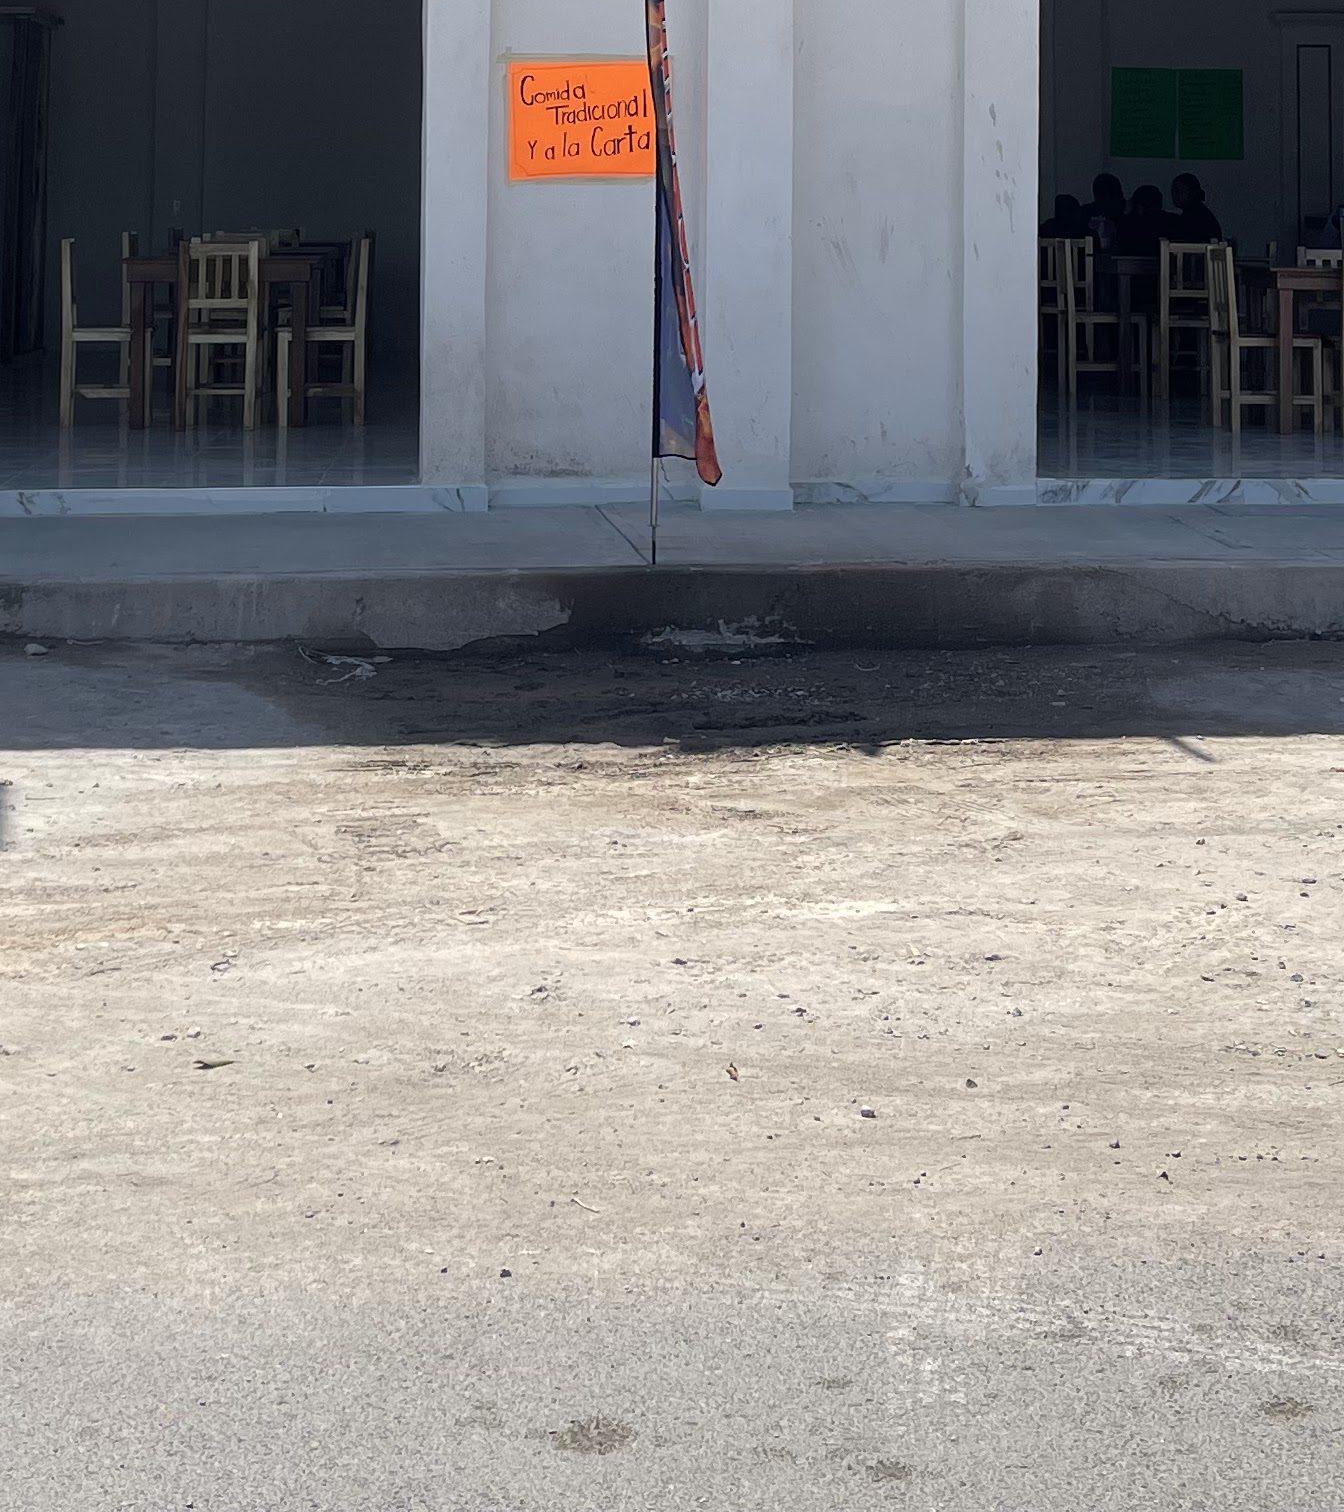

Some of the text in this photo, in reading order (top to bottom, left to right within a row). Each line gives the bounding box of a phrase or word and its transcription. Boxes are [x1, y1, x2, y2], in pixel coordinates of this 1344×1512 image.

[520, 74, 586, 106] Comida
[546, 88, 648, 125] Tradicional
[544, 145, 556, 160] a
[562, 131, 580, 157] la
[591, 124, 651, 157] Carta
